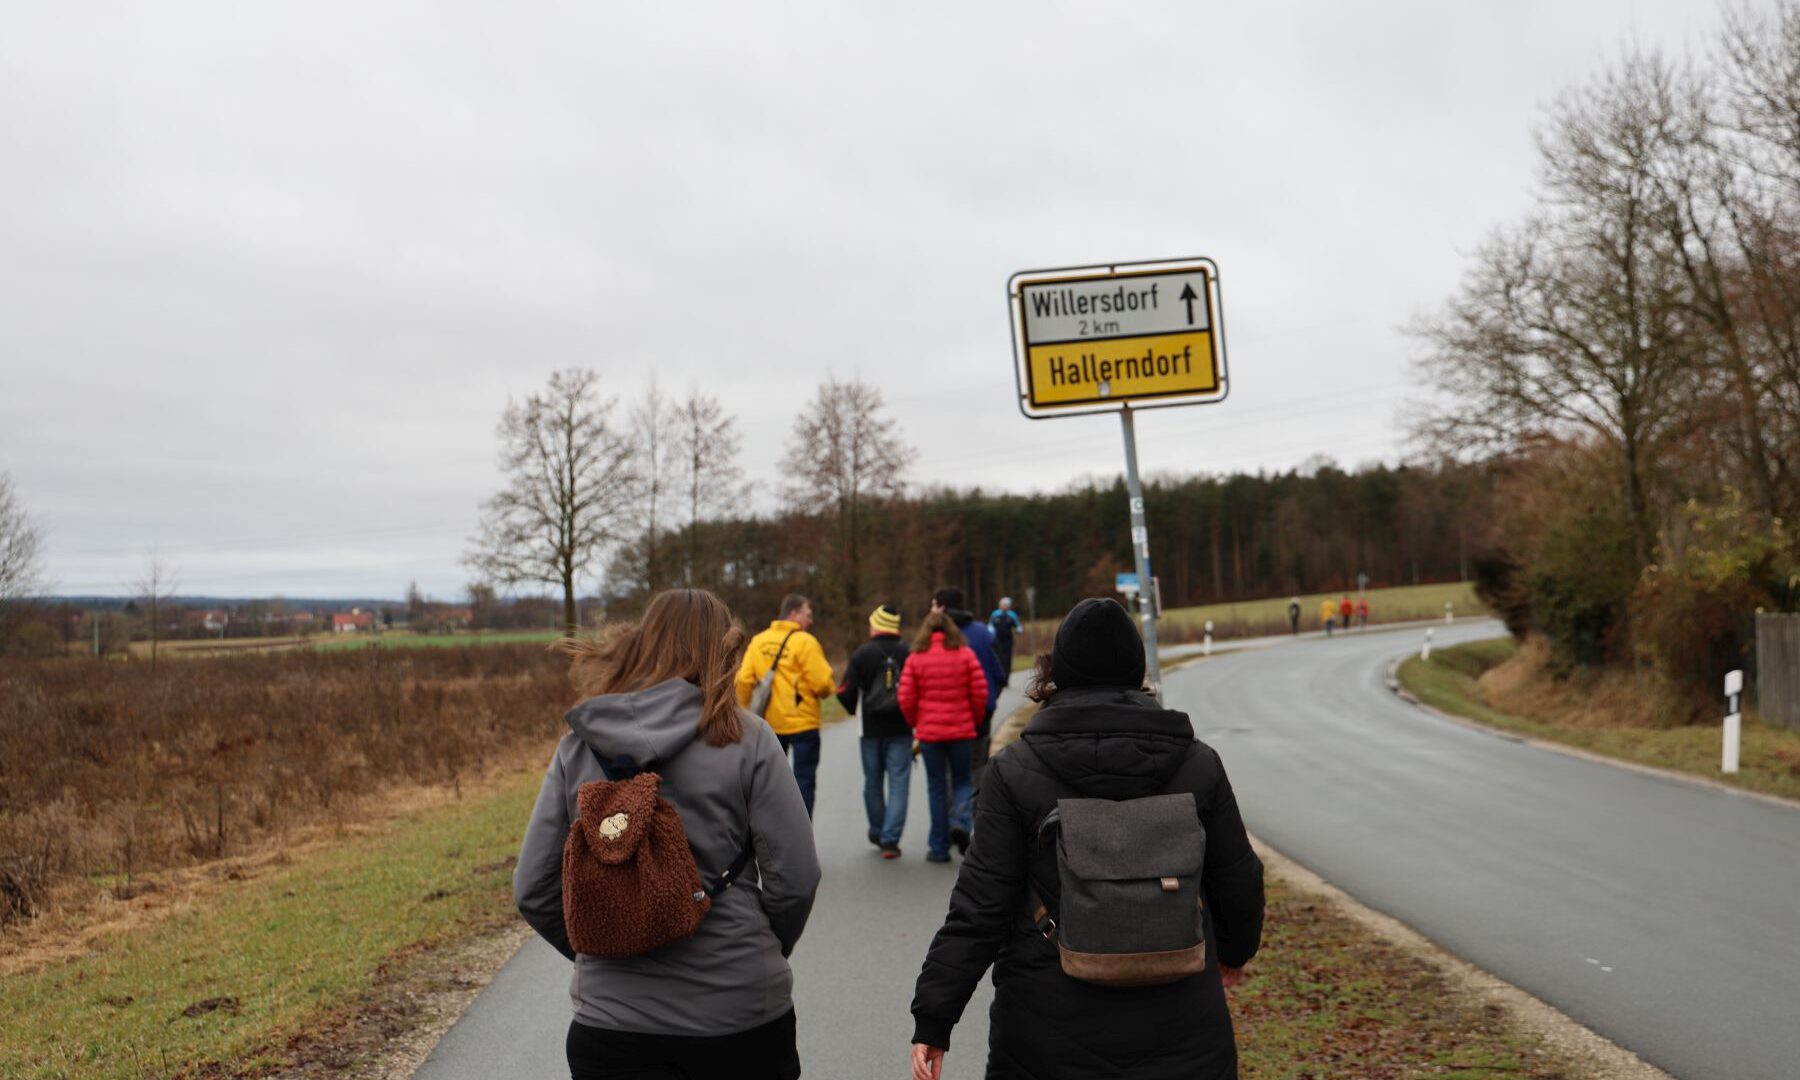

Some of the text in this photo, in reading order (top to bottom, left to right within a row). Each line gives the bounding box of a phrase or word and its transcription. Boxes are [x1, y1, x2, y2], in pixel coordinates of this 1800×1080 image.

[1032, 284, 1159, 318] Willersdorf
[1079, 320, 1120, 336] 2 km
[1050, 345, 1192, 386] Hallerndorf
